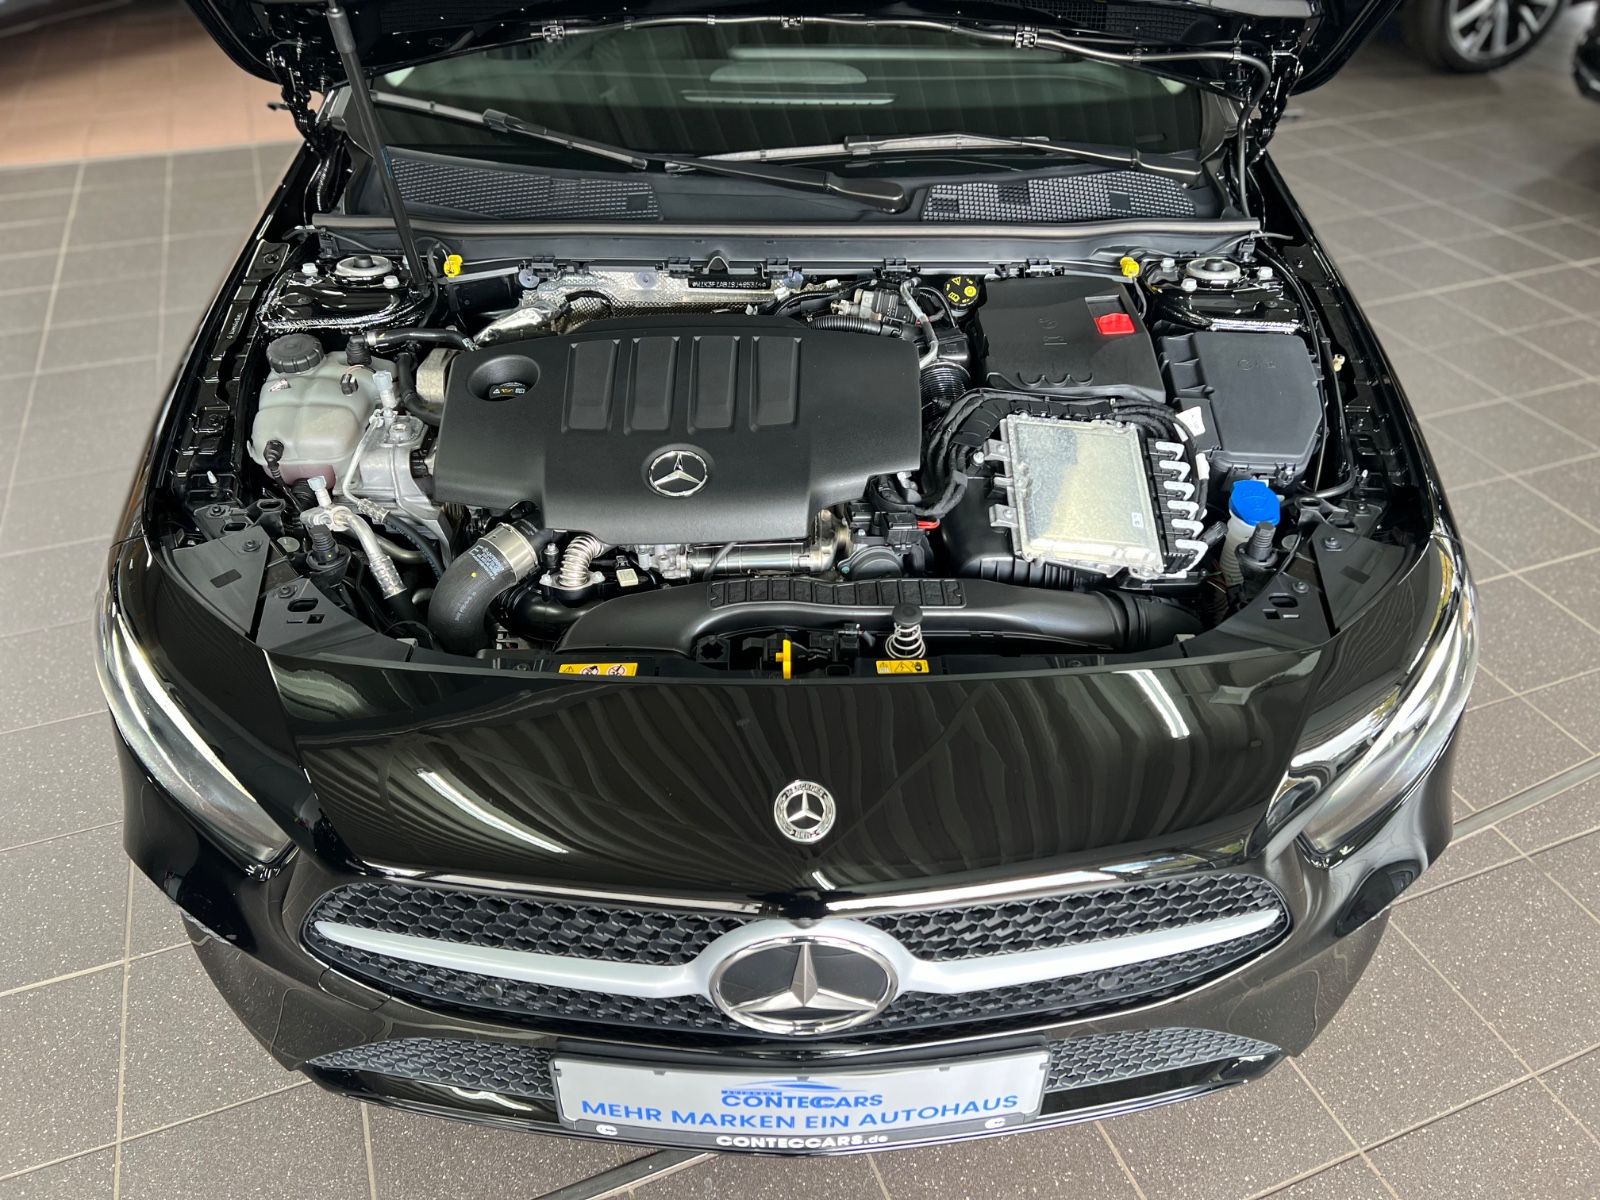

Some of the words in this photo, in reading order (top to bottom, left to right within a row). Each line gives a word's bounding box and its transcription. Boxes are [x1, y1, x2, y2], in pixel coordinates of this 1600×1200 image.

[721, 1095, 883, 1109] CONTECCARS
[581, 1100, 661, 1122] MEHR
[671, 1109, 795, 1129] MARKEN
[805, 1115, 849, 1129] EIN
[859, 1095, 1018, 1127] AUTOHAUS
[715, 1135, 888, 1148] CONTECCARS.de
